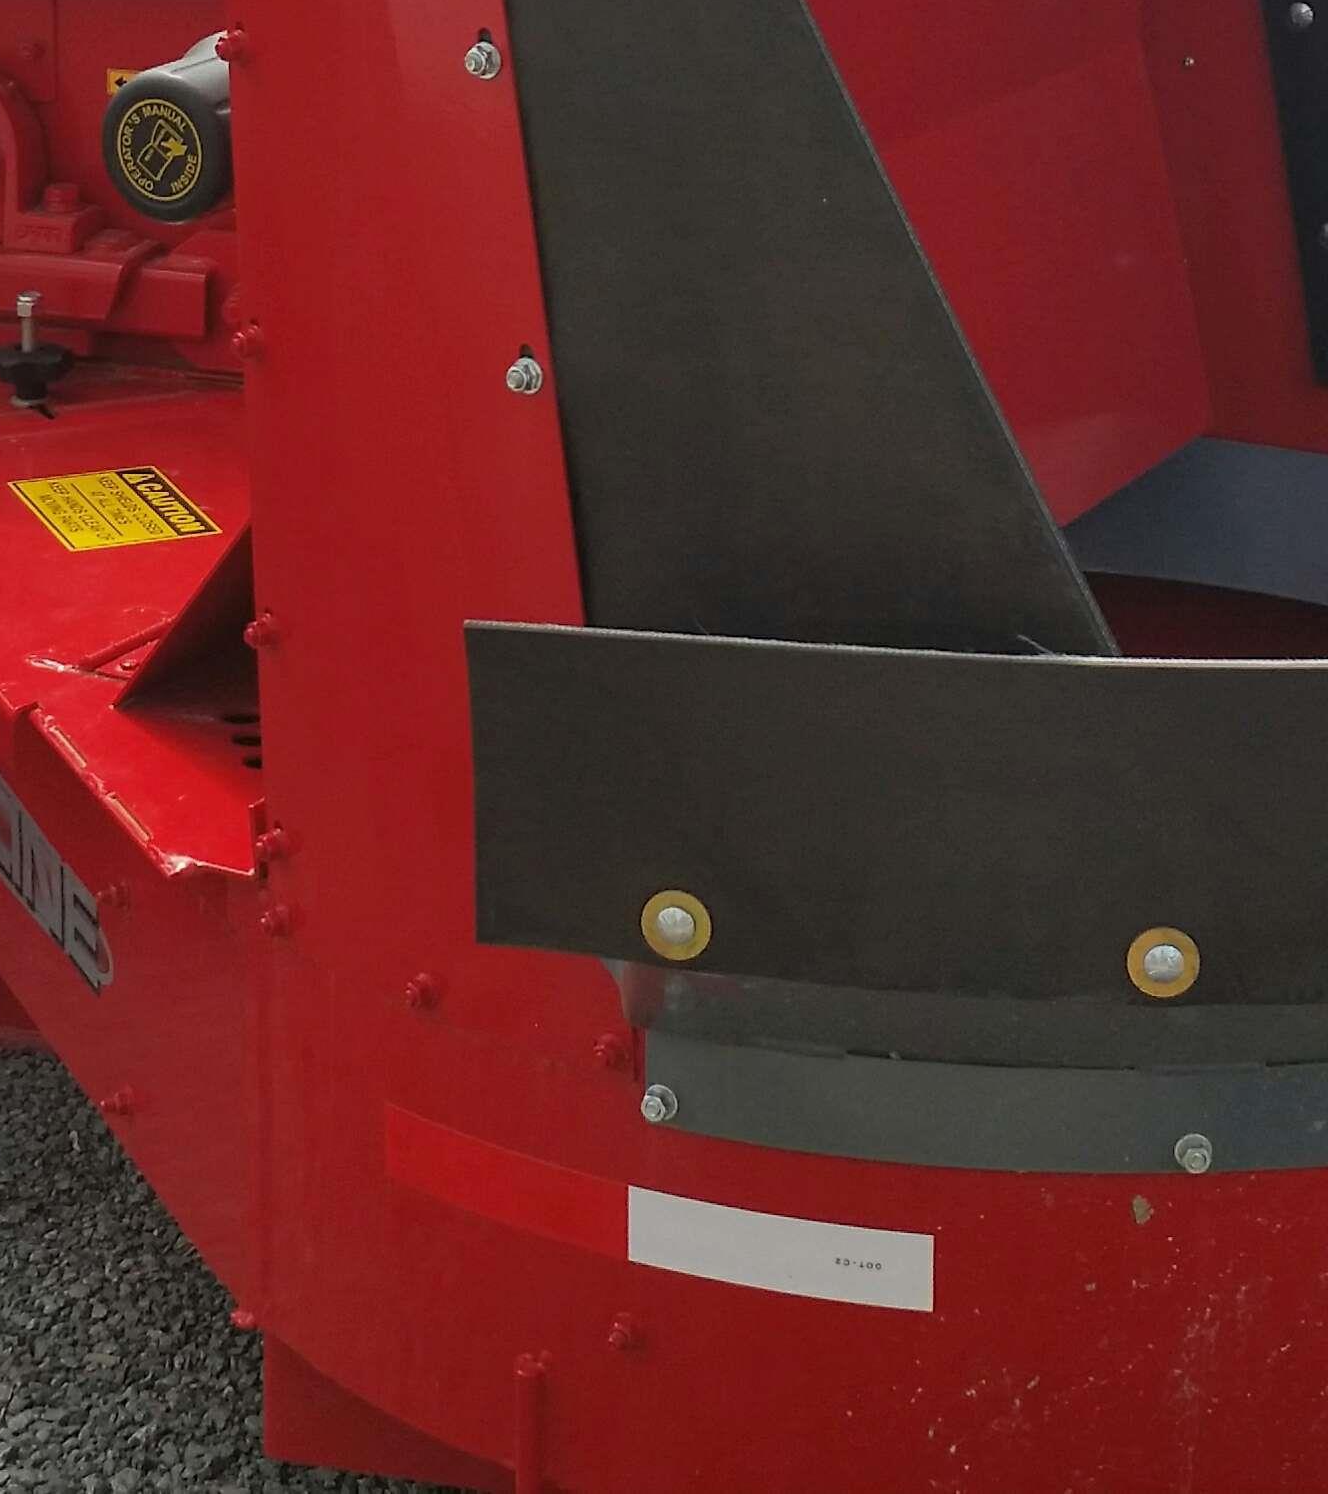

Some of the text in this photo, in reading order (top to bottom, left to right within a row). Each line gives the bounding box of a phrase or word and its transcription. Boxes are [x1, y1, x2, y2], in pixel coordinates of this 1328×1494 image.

[123, 105, 189, 191] OPERATOR'S MANUAL
[171, 155, 197, 192] INSIDE
[137, 482, 206, 533] CAUTION
